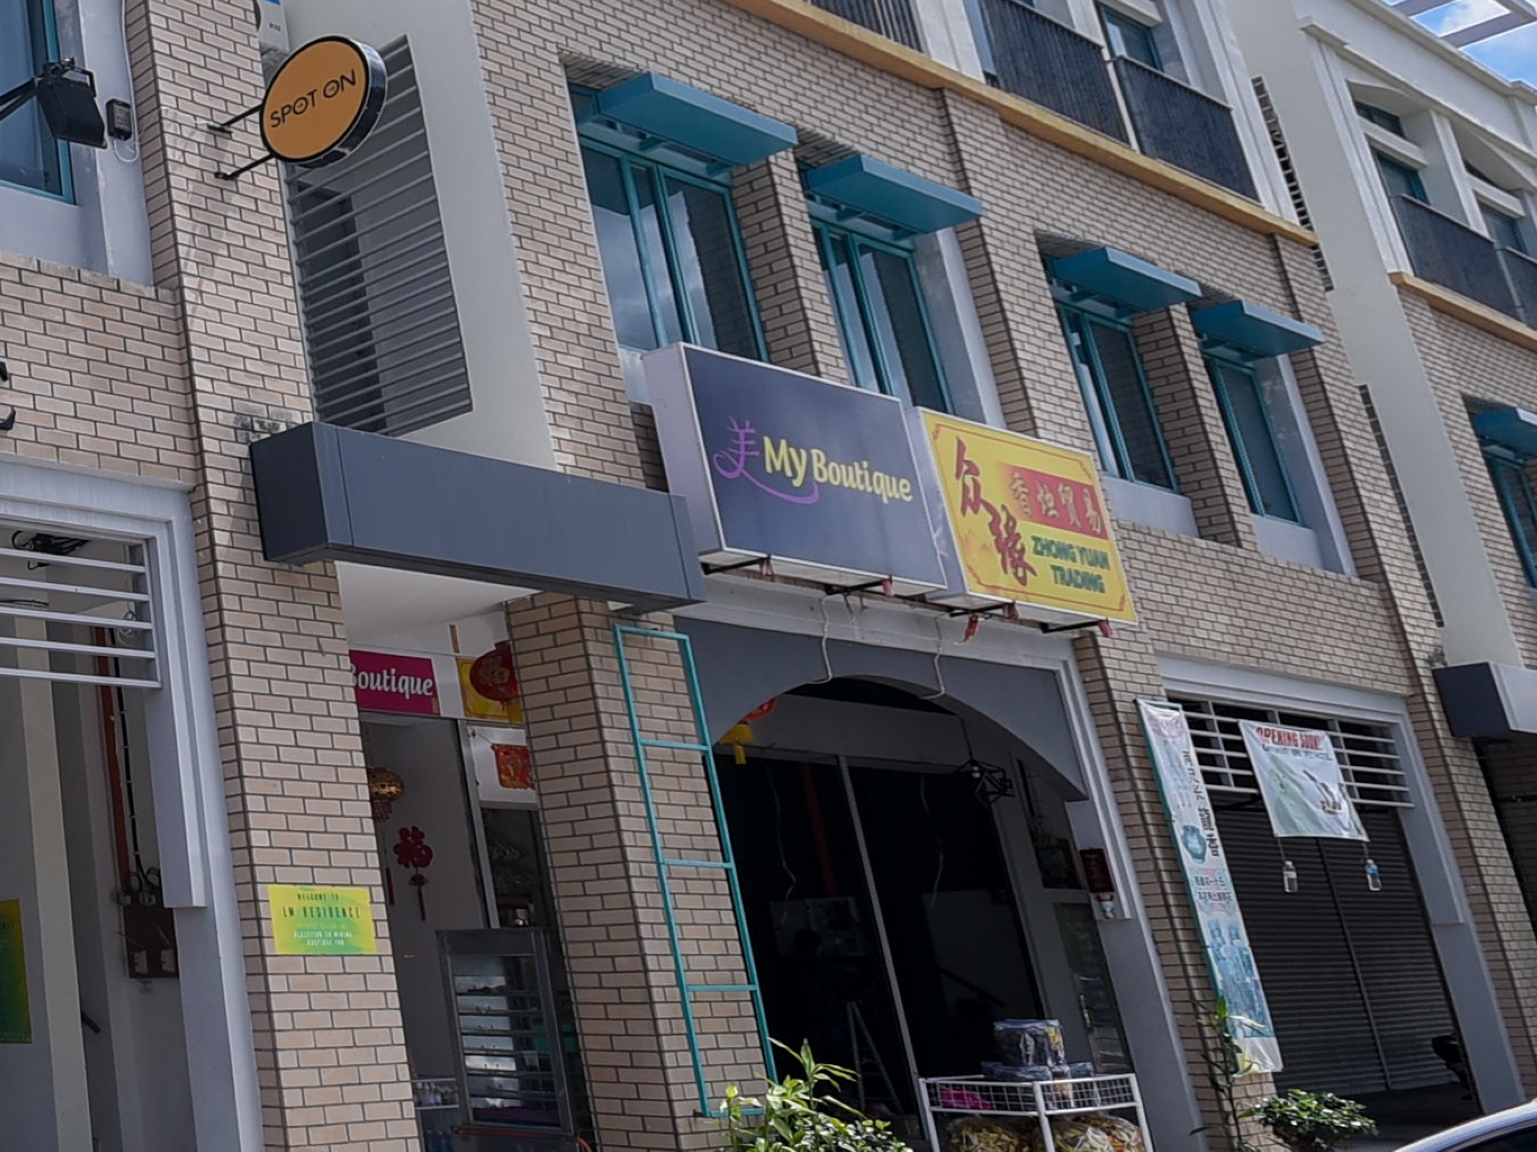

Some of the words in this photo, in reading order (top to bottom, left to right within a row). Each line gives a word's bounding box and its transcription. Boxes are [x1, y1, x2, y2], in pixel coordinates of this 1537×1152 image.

[269, 87, 319, 129] SPOT
[322, 68, 357, 99] ON
[763, 435, 808, 488] My
[810, 448, 914, 505] Boutique
[1030, 534, 1077, 563] ZHONG
[1076, 544, 1111, 572] YUAN
[1049, 564, 1107, 595] TRADING
